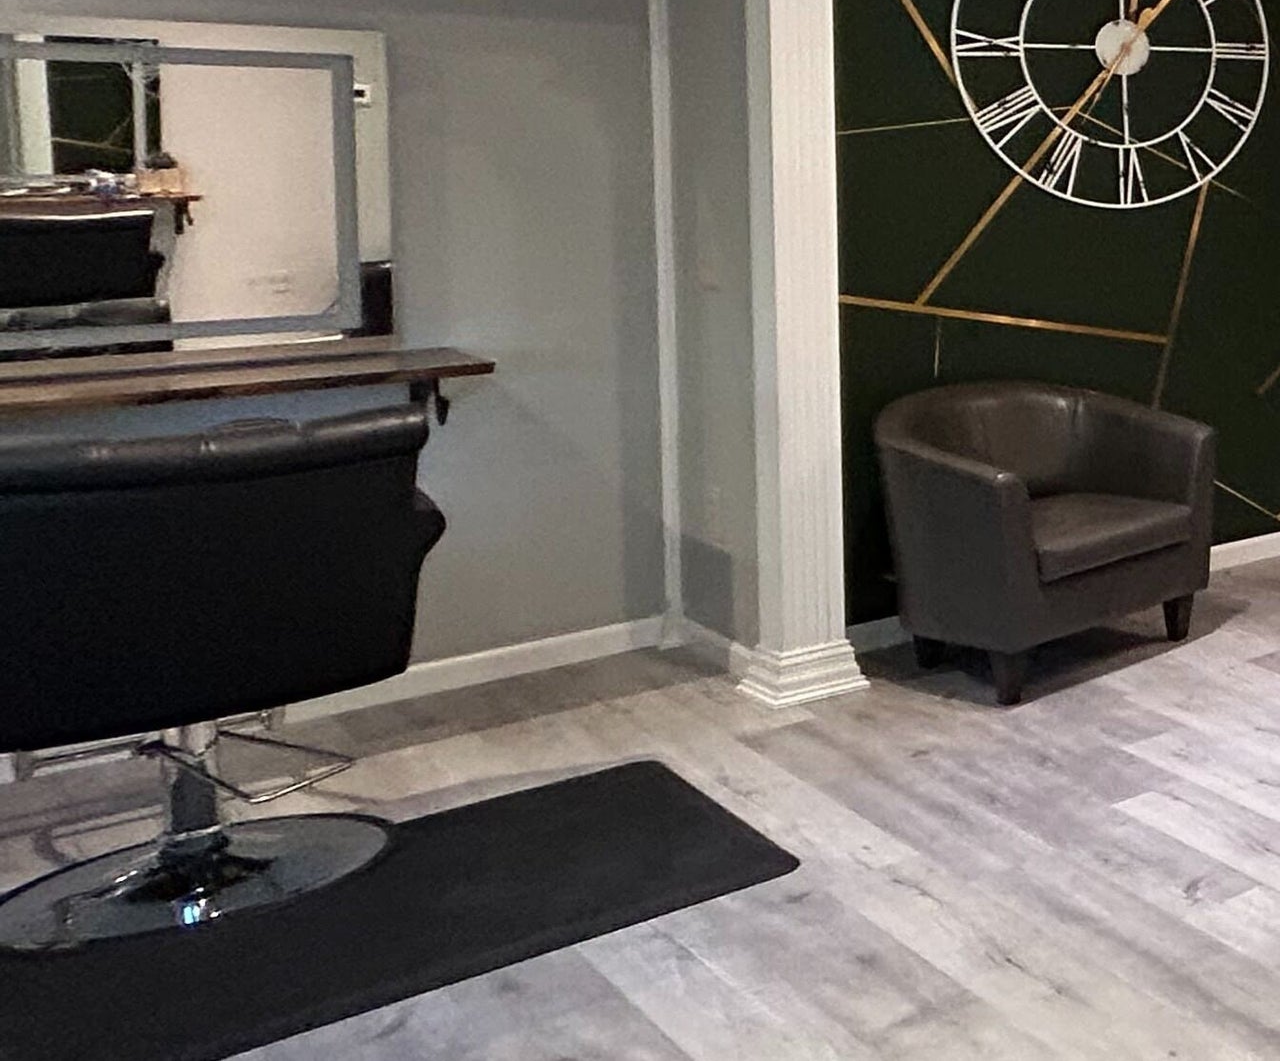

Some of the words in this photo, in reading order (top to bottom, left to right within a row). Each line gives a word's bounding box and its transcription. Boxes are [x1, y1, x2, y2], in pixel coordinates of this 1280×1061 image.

[956, 28, 1022, 57] IX
[1214, 42, 1266, 60] III
[975, 86, 1040, 148] VIII
[1206, 89, 1256, 131] IV
[1039, 131, 1081, 196] VII
[1118, 147, 1149, 204] VI
[1178, 129, 1219, 183] V
